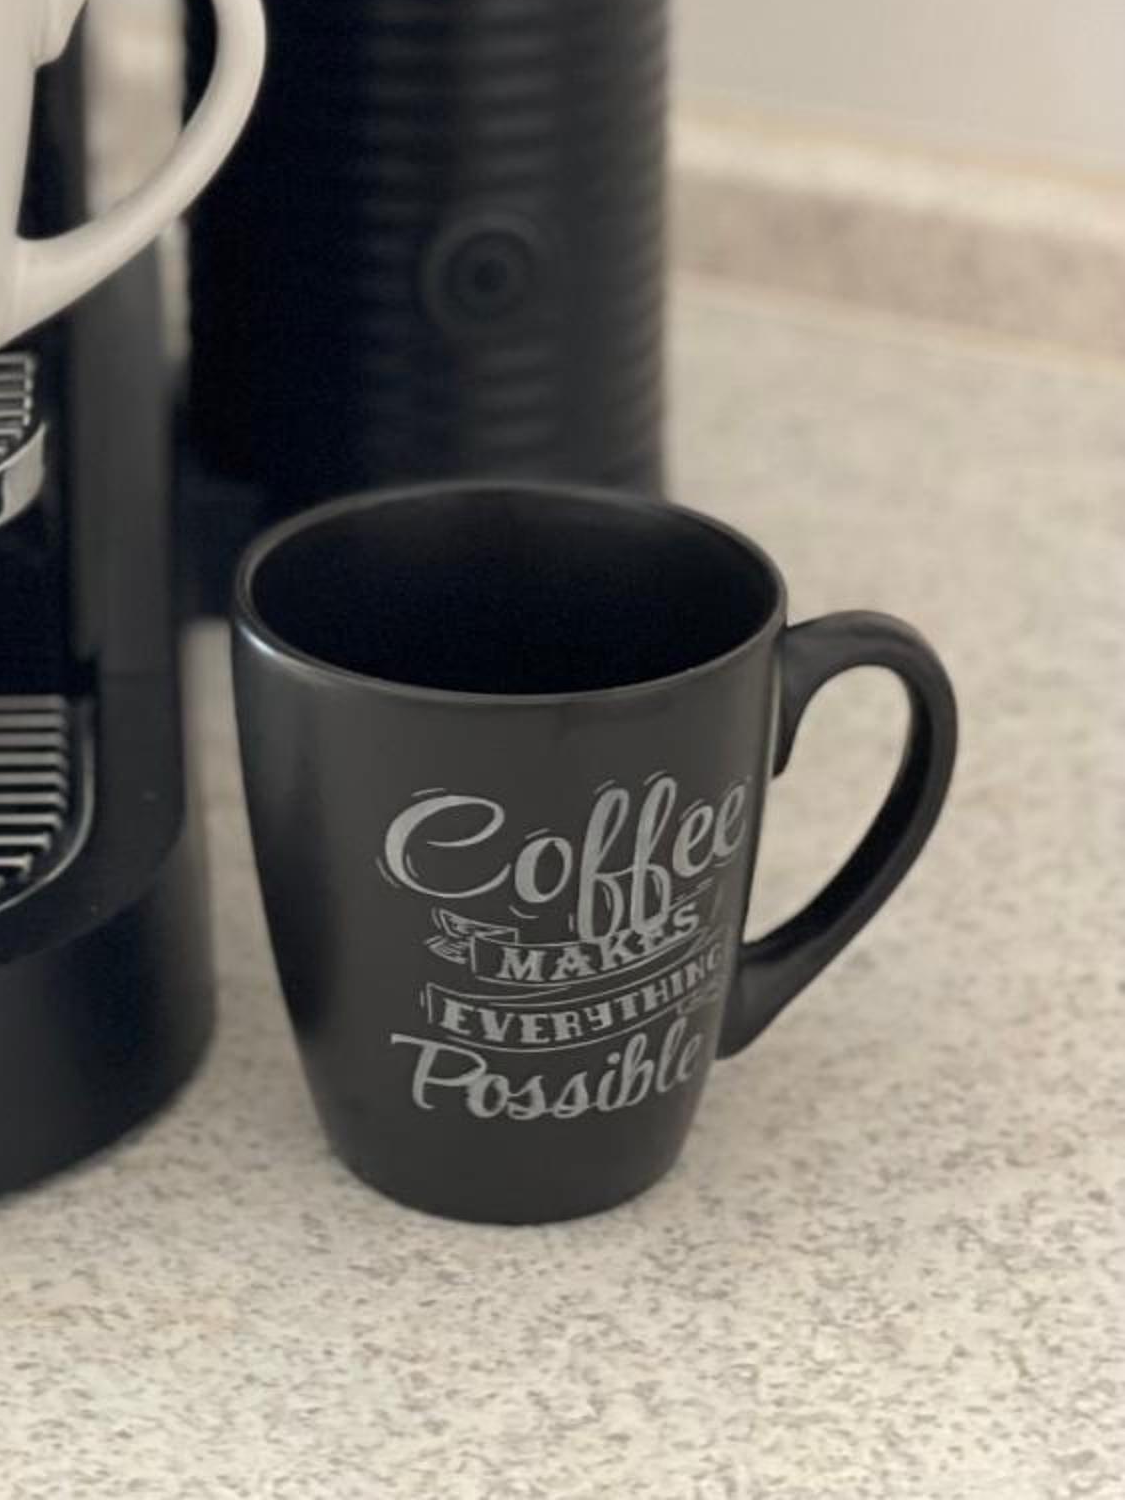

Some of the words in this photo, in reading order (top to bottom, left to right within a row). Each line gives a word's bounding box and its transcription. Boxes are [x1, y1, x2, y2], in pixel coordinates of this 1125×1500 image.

[384, 777, 748, 944] Coffee
[496, 901, 700, 982] MAKES
[440, 943, 724, 1045] EVERYTHING
[390, 1017, 705, 1121] Possible
